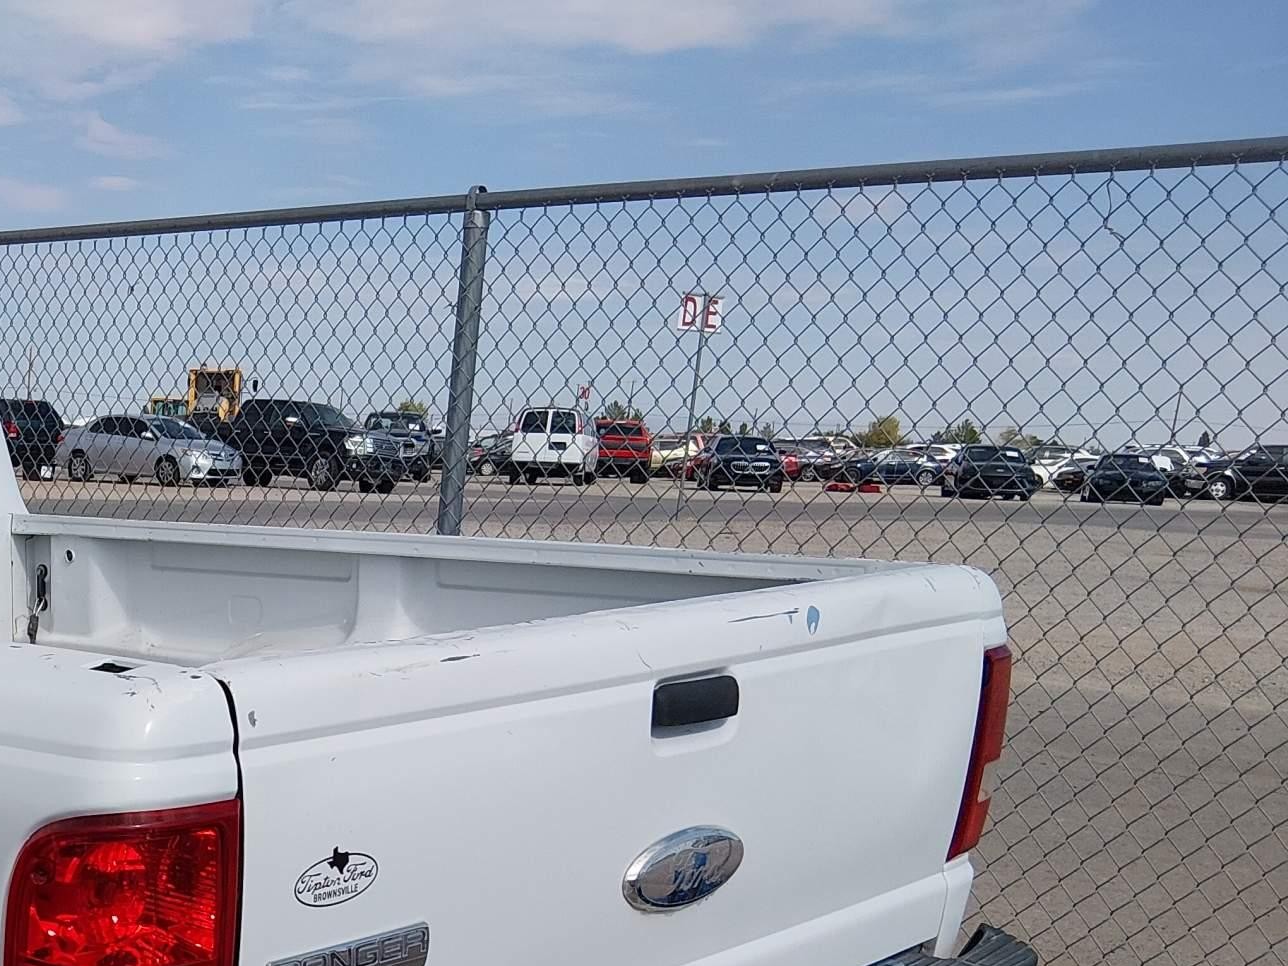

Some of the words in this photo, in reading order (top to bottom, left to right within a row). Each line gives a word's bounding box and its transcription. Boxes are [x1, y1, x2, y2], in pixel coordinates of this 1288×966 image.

[297, 872, 341, 895] Tipton
[343, 861, 375, 883] Ford
[313, 883, 359, 903] BROWNSVILLE
